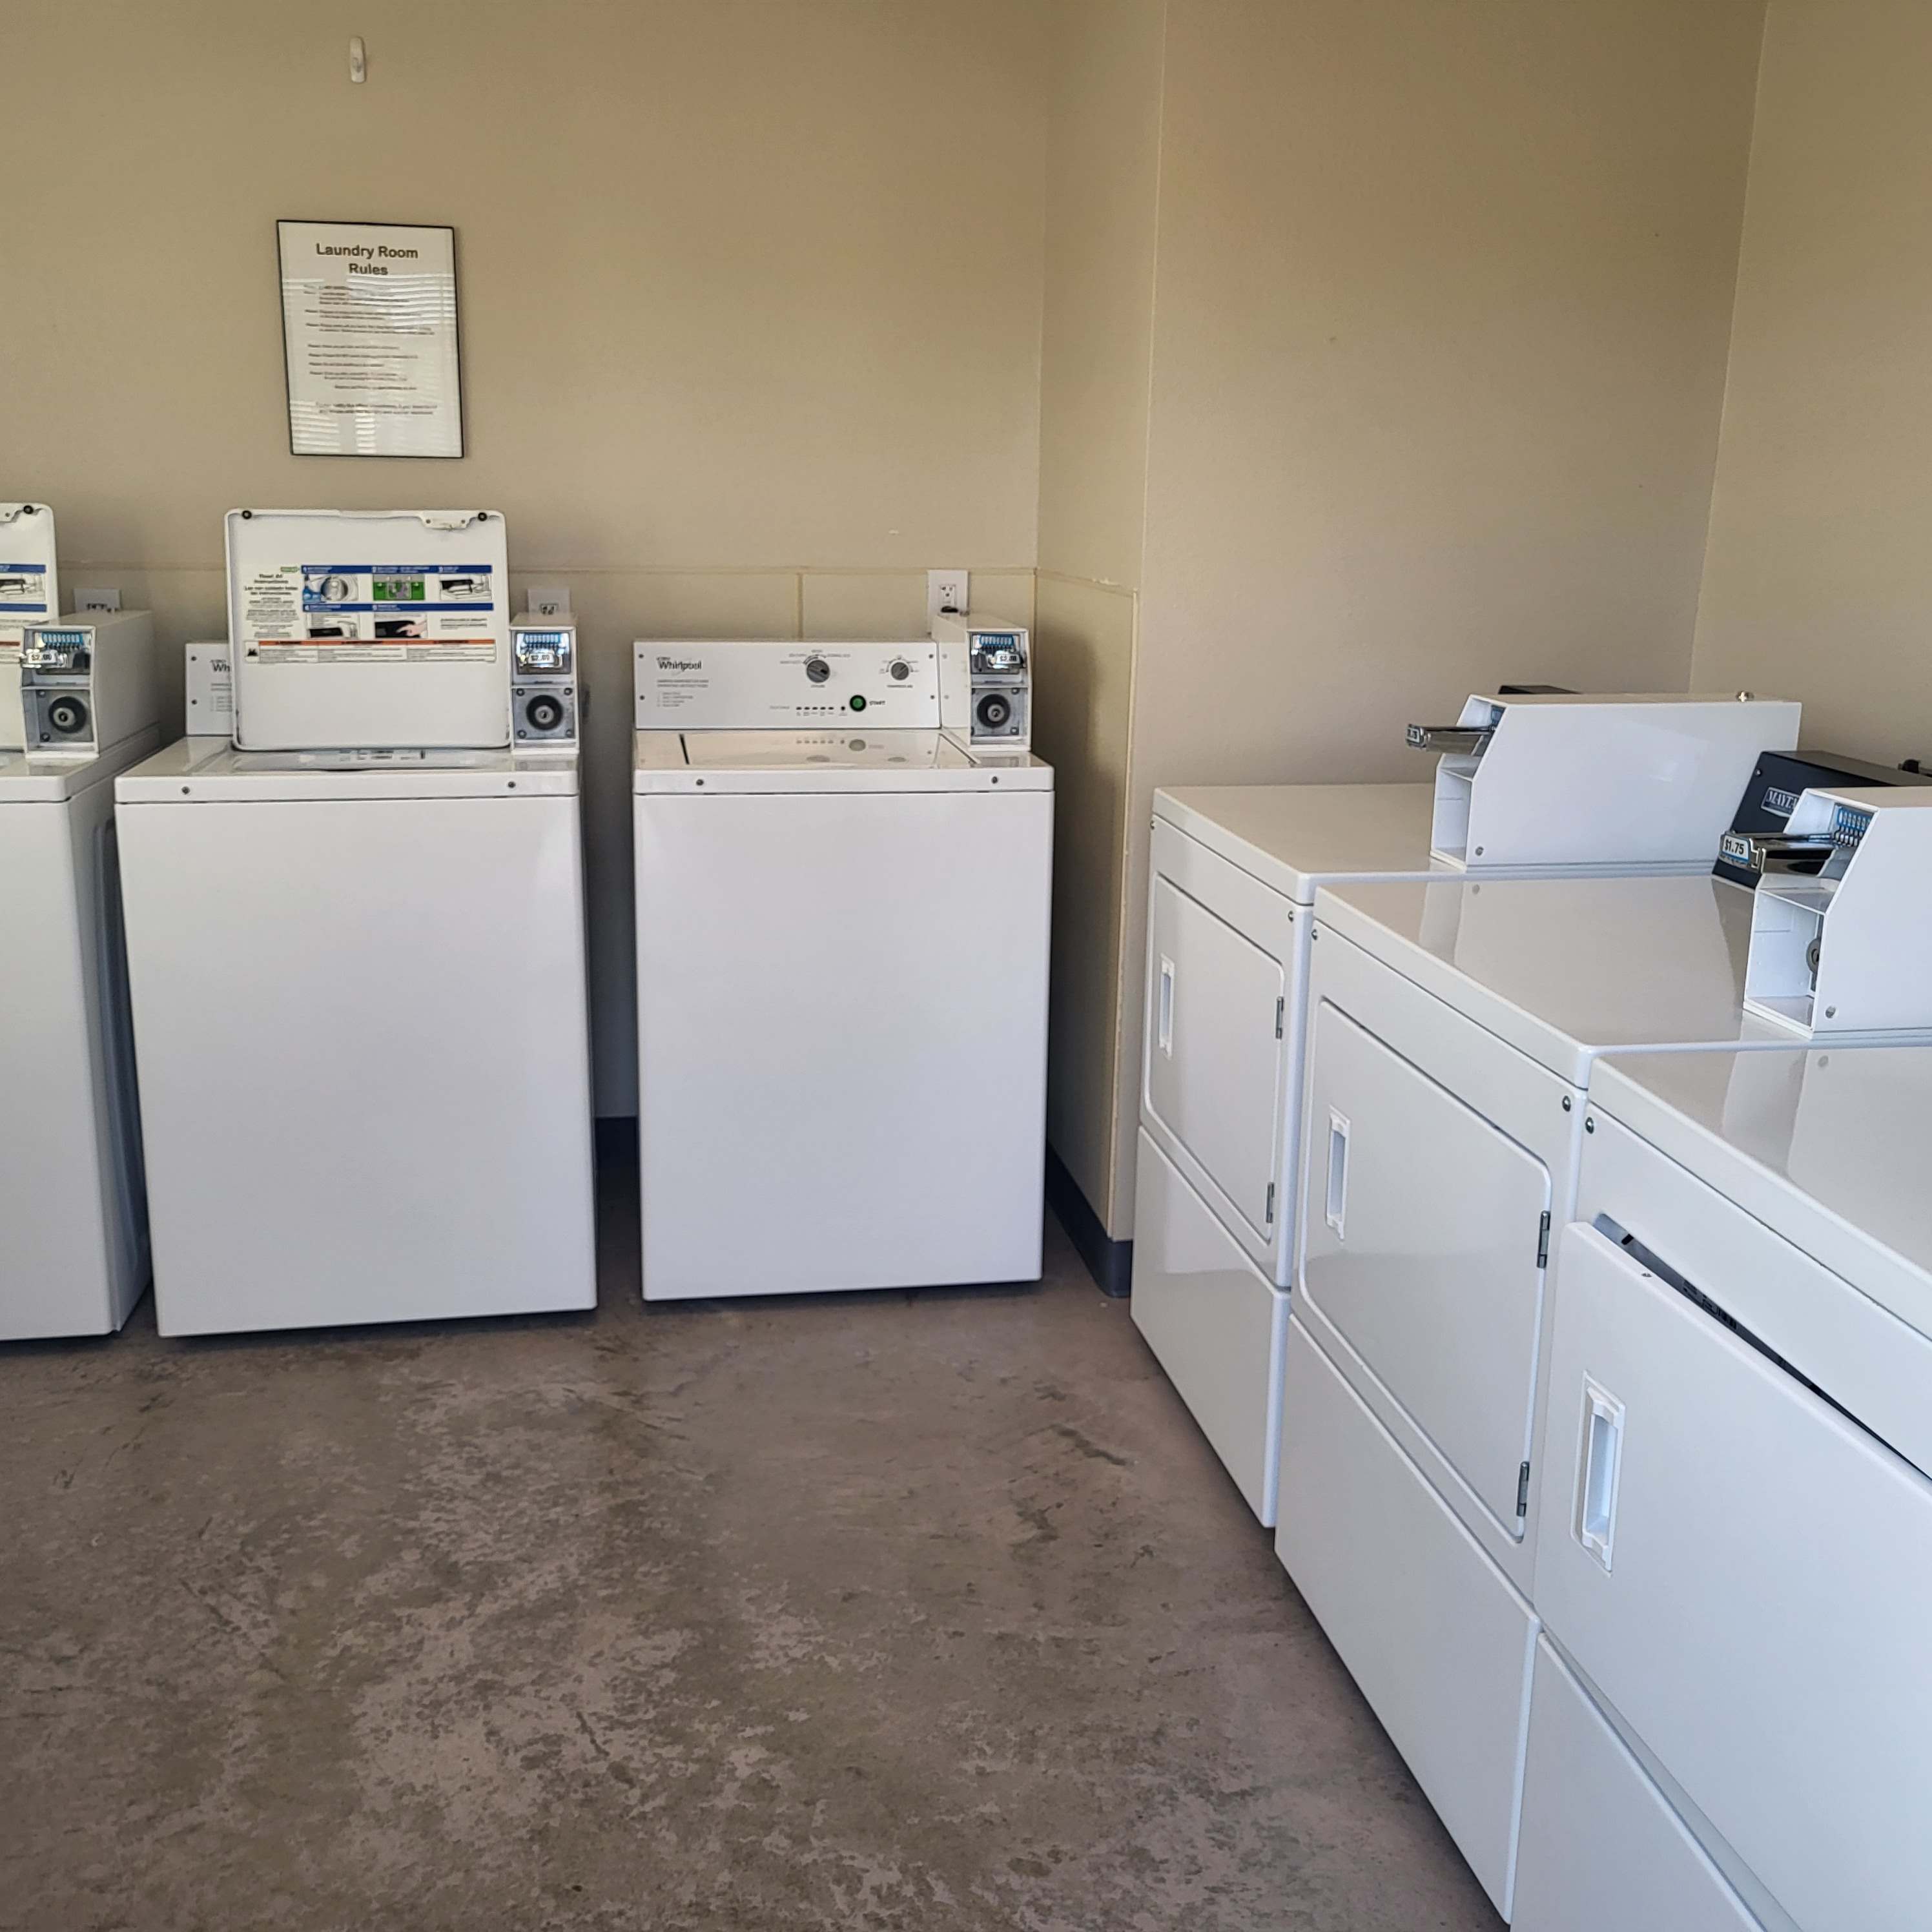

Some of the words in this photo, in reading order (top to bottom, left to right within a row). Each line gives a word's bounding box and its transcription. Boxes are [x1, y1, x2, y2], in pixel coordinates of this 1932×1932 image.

[316, 243, 375, 260] Laundry
[378, 246, 418, 258] Room
[349, 263, 389, 275] Rules
[657, 660, 702, 672] Whirlpool
[1765, 790, 1798, 809] MAYTA
[1724, 838, 1745, 855] $1.75
